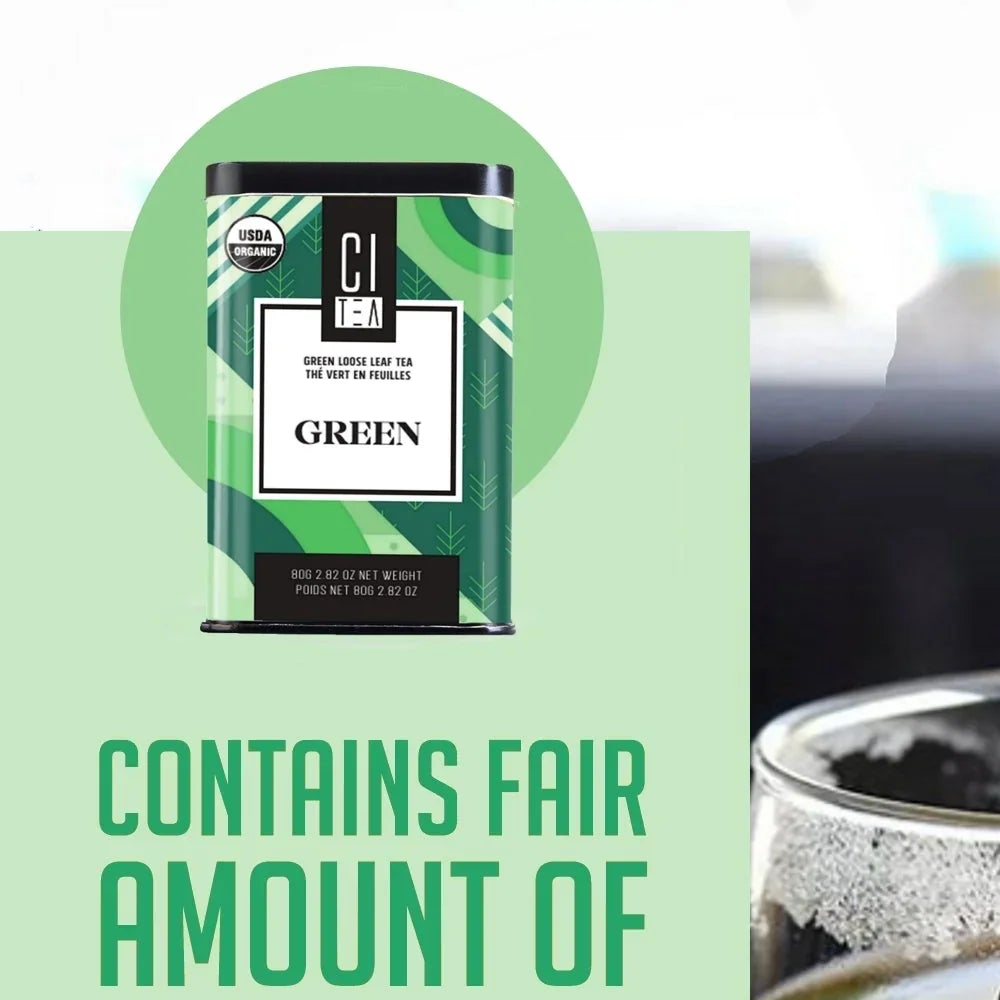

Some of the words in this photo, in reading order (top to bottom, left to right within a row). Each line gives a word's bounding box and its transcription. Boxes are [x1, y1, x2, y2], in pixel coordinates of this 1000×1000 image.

[238, 229, 272, 242] USDA
[234, 246, 276, 257] ORGANIC
[341, 232, 376, 293] CI
[339, 299, 379, 326] TEA
[304, 356, 334, 366] GREEN
[338, 356, 367, 366] LOOSE
[370, 357, 392, 366] LEAF
[396, 357, 413, 367] TEA
[305, 367, 323, 379] THÉ
[327, 369, 350, 380] VERT
[353, 370, 366, 380] EN
[369, 370, 411, 380] FEUILLES
[295, 420, 421, 446] GREEN
[291, 570, 312, 580] 80G
[316, 570, 339, 580] 2.82
[343, 570, 355, 580] OZ
[359, 571, 378, 581] NET
[382, 571, 422, 581] WEIGHT
[296, 585, 327, 595] POIDS
[329, 585, 349, 595] NET
[353, 586, 374, 596] 80G
[404, 586, 418, 596] OZ
